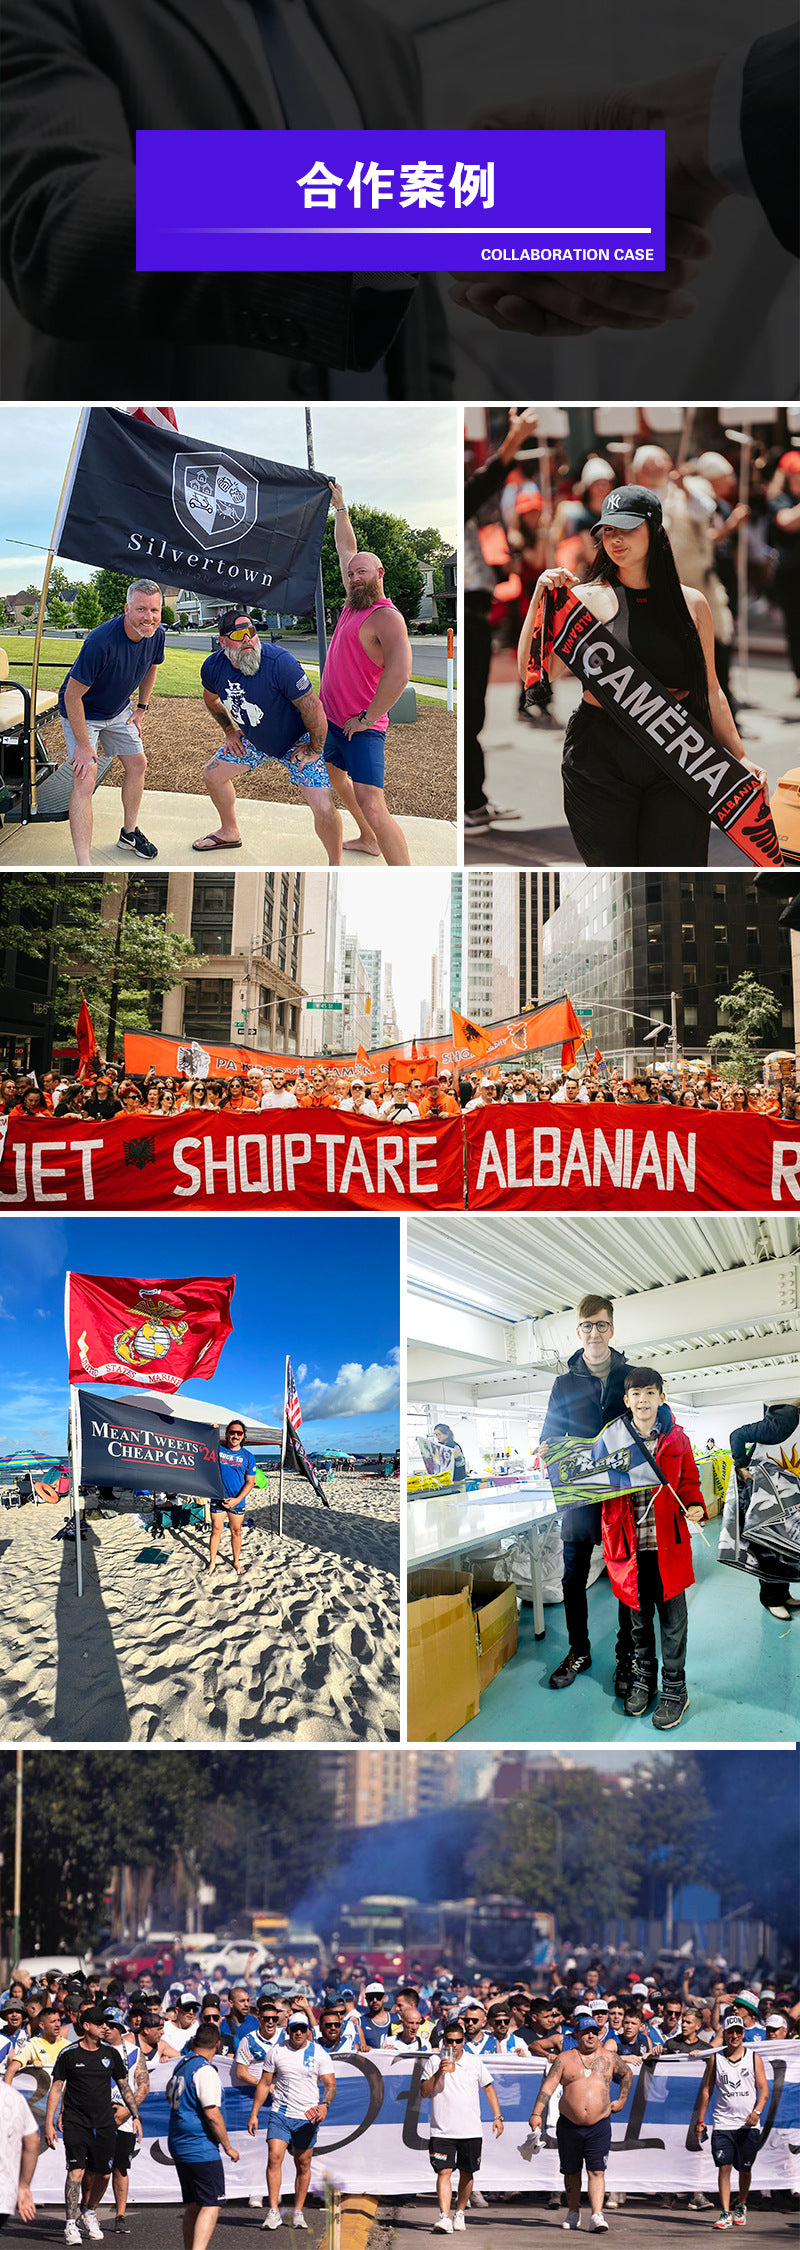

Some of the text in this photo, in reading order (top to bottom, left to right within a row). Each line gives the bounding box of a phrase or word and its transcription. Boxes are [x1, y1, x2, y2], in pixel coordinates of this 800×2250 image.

[127, 532, 274, 588] Silvertown
[561, 611, 593, 655] ALBANIA
[716, 779, 761, 822] ALBANIA
[216, 1058, 237, 1071] PA
[173, 1132, 439, 1197] SHQIPTARE
[476, 1127, 697, 1193] ALBANIAN
[105, 1365, 137, 1379] STATES
